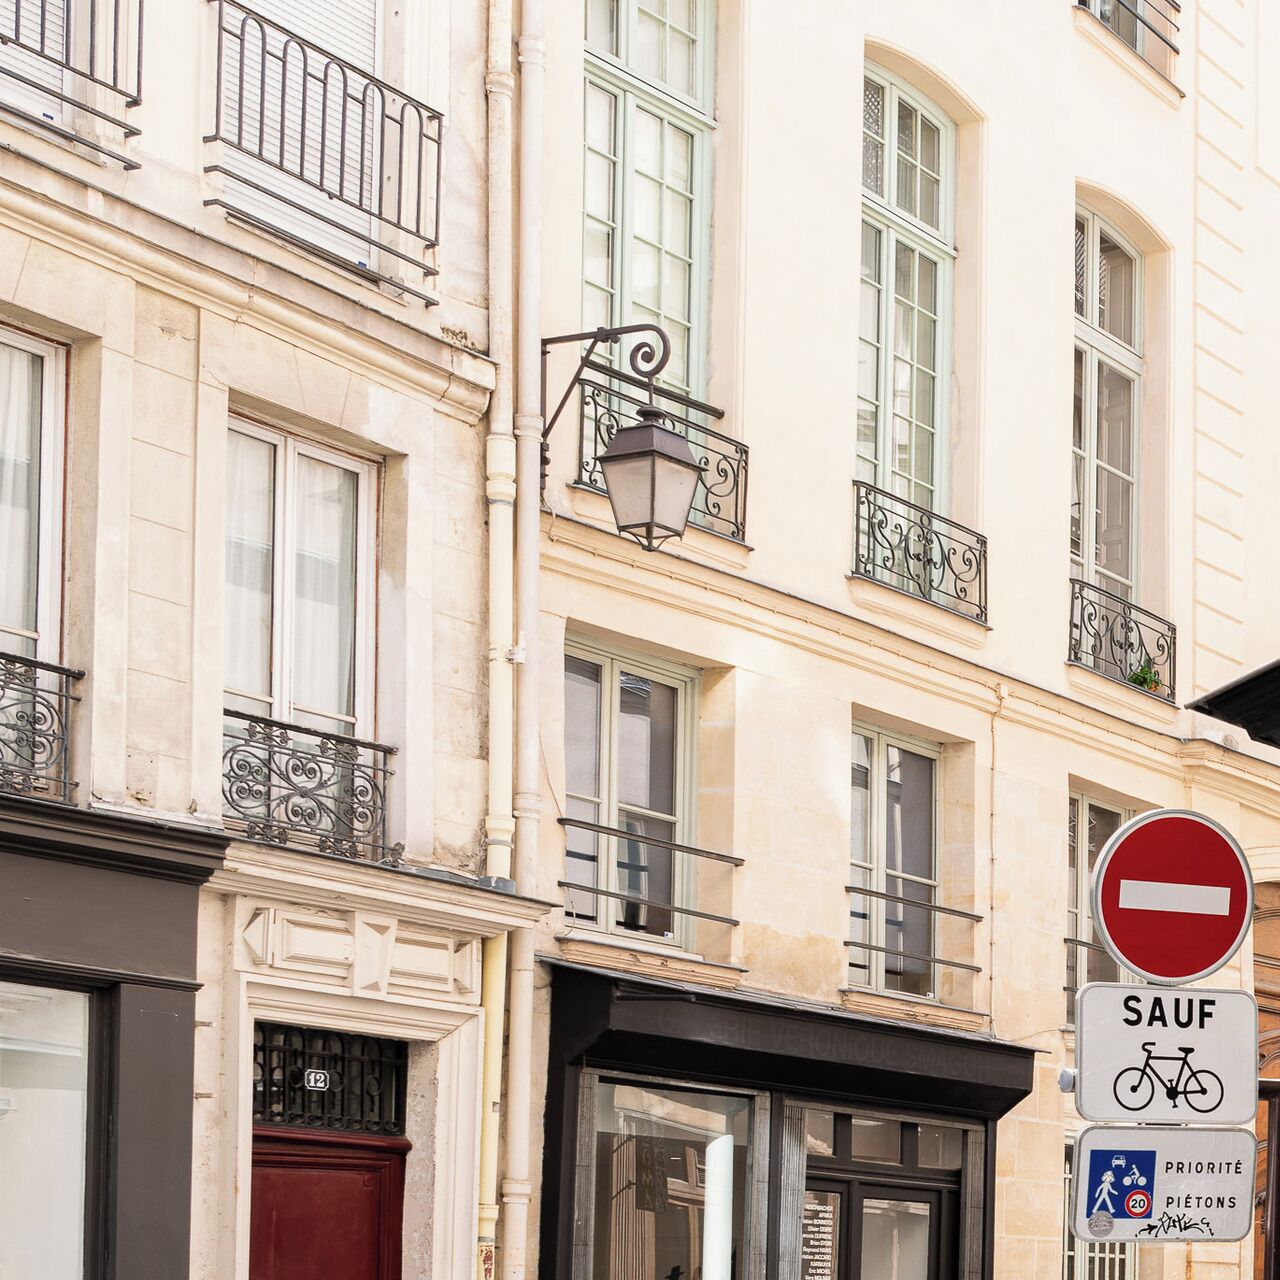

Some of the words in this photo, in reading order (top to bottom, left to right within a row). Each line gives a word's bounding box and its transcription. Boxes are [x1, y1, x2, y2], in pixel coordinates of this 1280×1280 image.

[1122, 995, 1216, 1030] SAUF
[309, 1073, 325, 1087] 12
[1165, 1159, 1243, 1176] PRIORITÉ
[1131, 1198, 1146, 1209] 20
[1166, 1192, 1237, 1210] PIÉTONS
